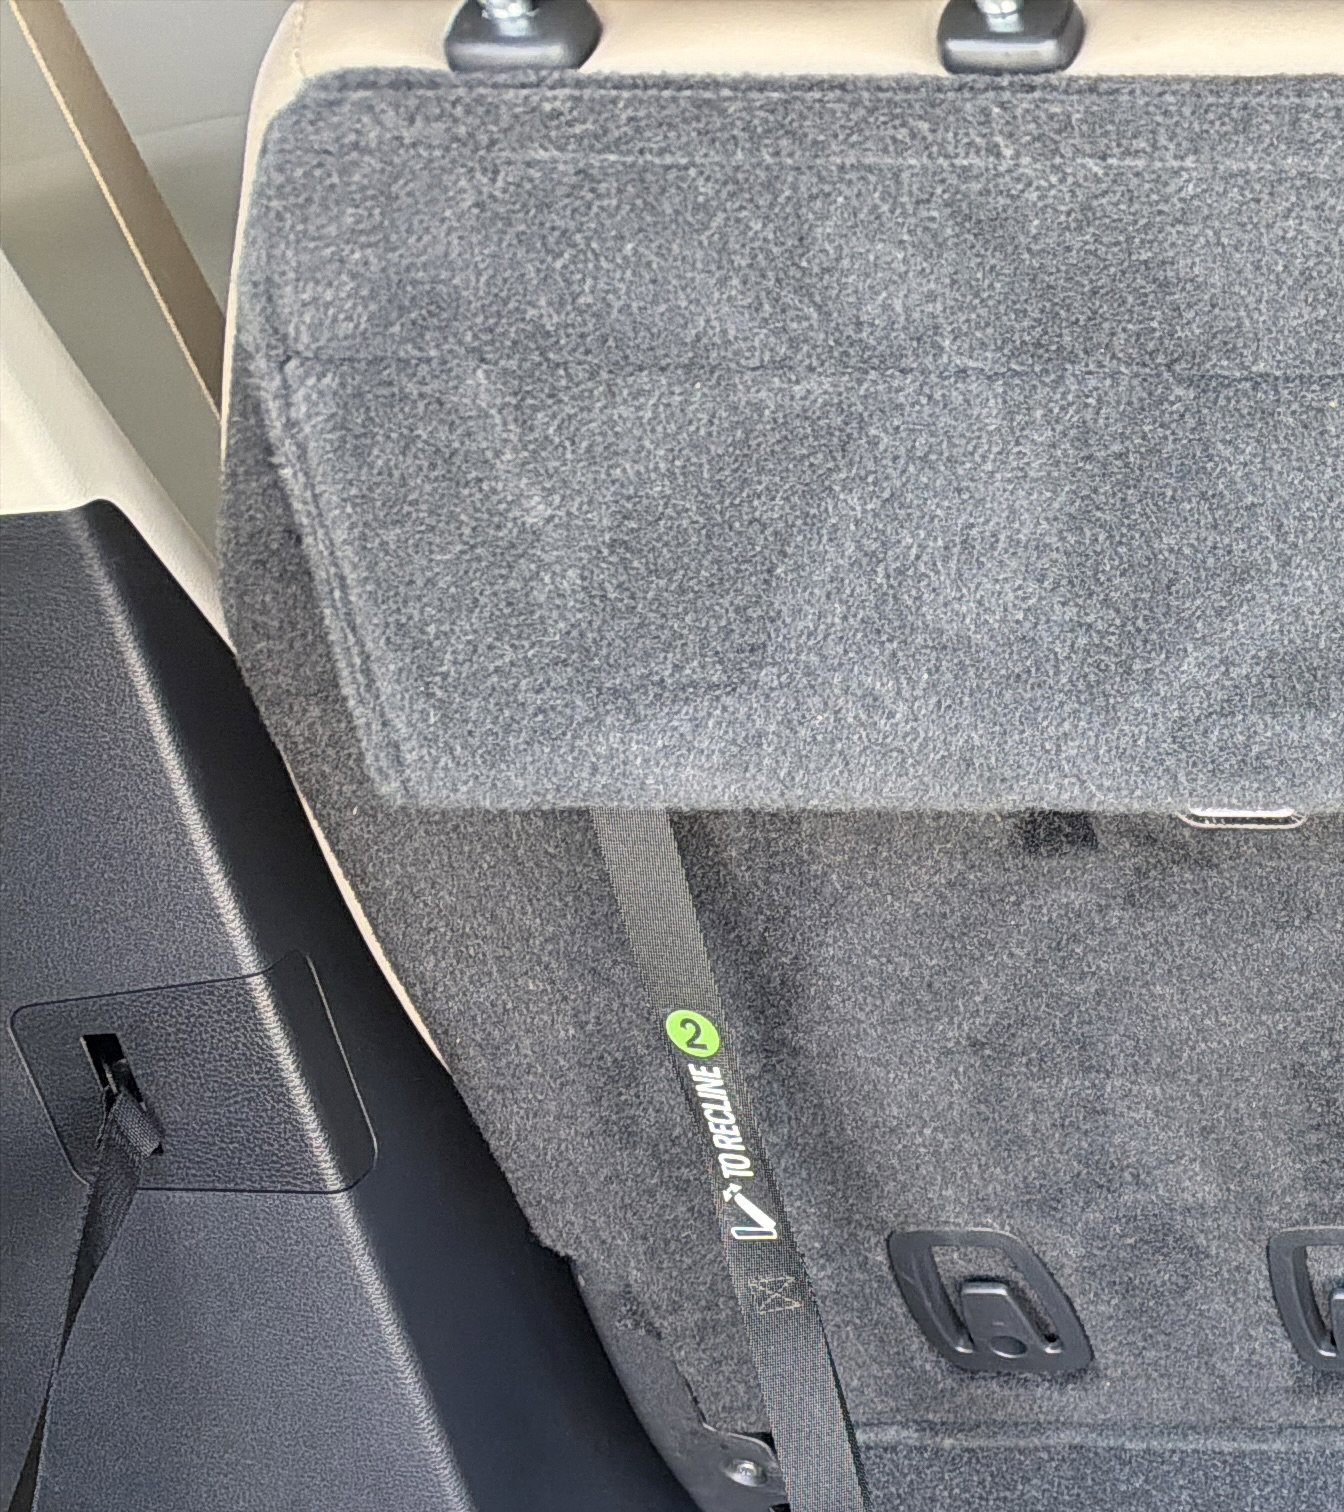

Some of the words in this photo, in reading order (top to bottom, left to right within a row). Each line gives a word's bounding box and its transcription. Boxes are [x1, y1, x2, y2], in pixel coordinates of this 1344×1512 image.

[680, 1017, 708, 1050] 2
[688, 1063, 746, 1151] RECLINE
[717, 1153, 754, 1178] TO
